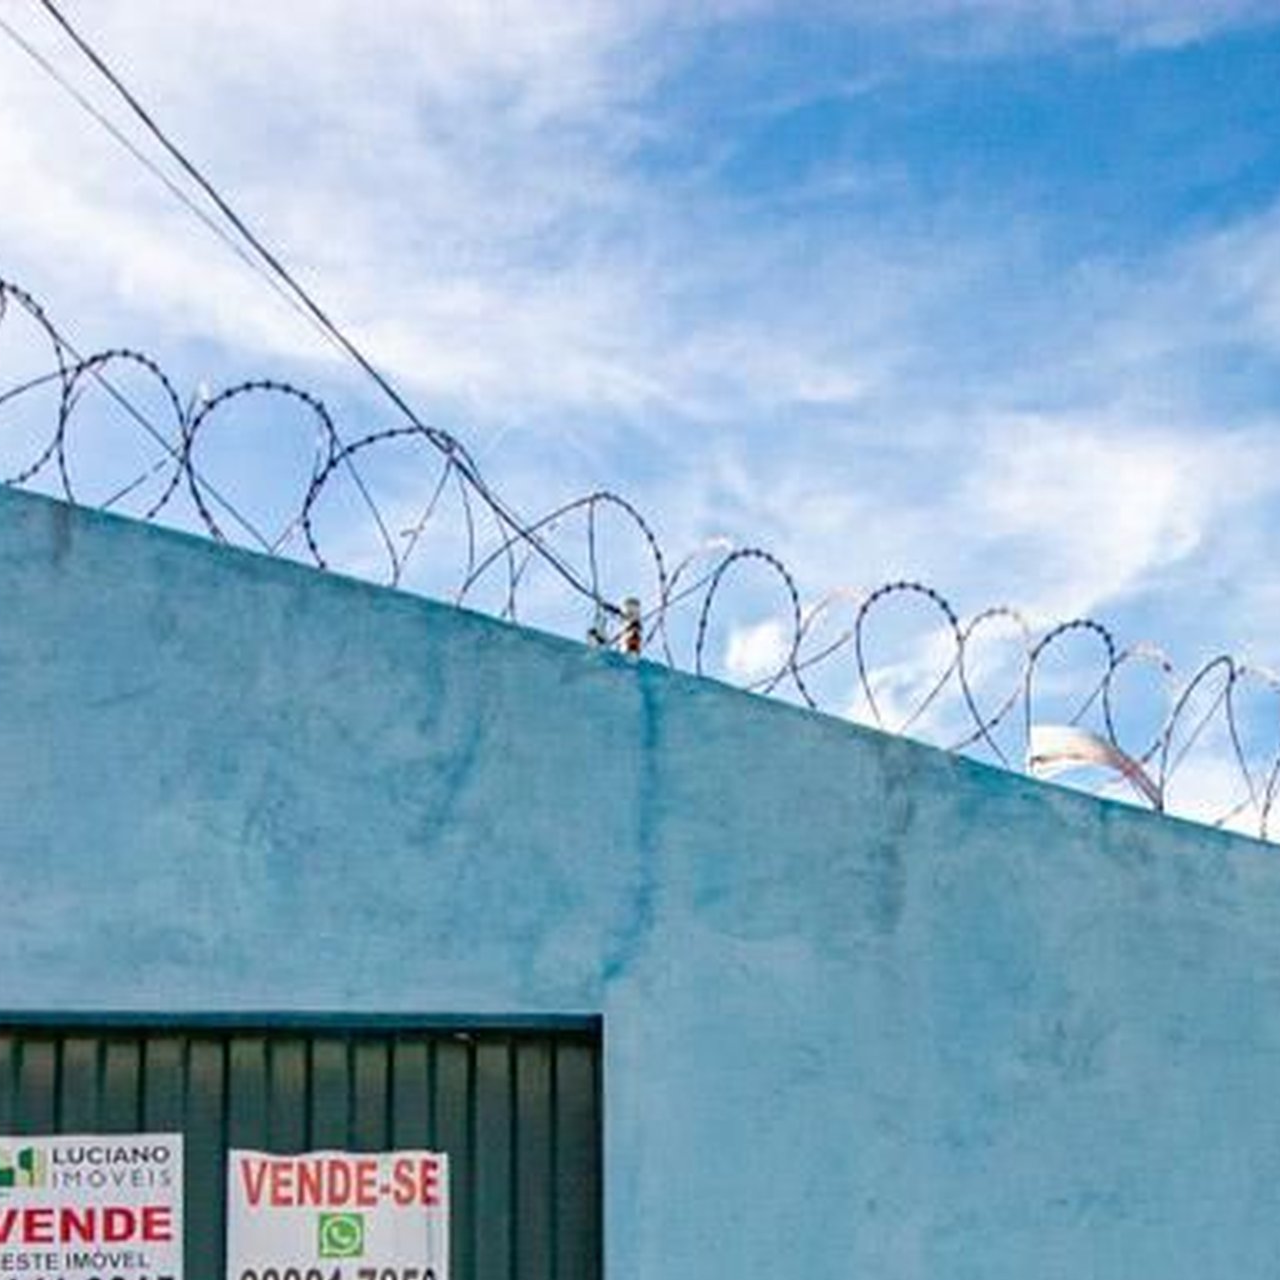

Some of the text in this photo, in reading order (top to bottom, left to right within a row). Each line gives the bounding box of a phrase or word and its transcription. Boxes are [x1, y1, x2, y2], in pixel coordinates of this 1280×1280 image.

[52, 1147, 171, 1165] LUCIANO
[241, 1158, 439, 1206] VENDE-SE
[1, 1253, 60, 1271] ESTE
